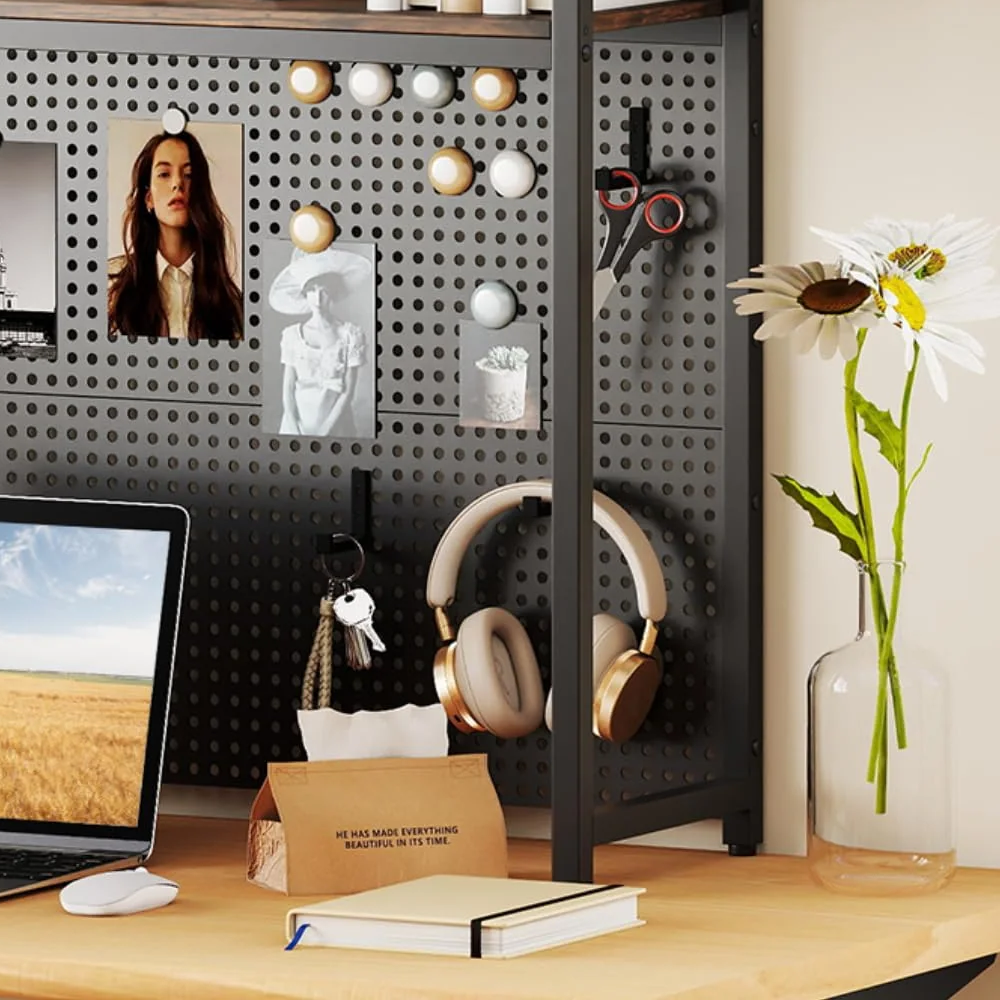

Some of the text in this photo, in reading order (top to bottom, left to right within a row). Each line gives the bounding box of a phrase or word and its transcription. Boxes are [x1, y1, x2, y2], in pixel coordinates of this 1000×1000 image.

[336, 826, 459, 839] HE HAS MADE EVERYTHING
[345, 837, 451, 850] BEAUTIFUL IN ITS TIME.
